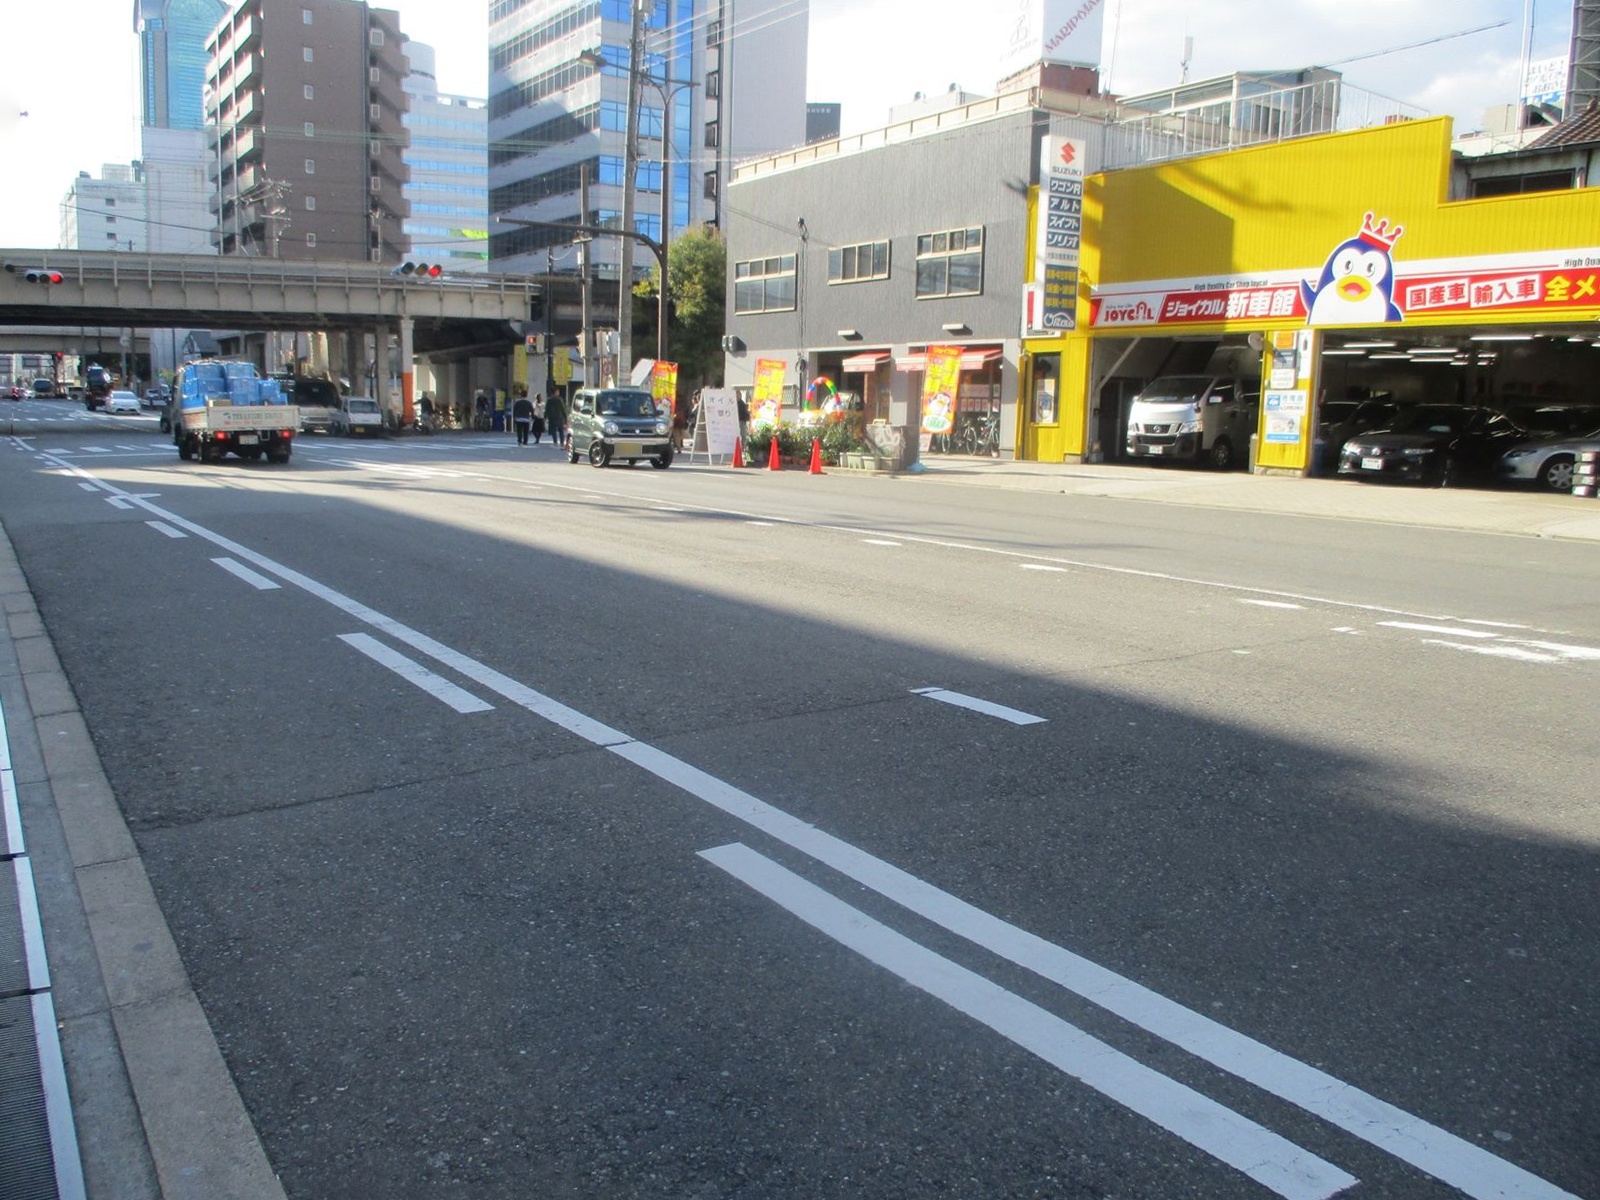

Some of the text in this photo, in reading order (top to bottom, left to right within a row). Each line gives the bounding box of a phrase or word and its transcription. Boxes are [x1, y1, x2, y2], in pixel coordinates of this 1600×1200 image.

[1052, 165, 1082, 177] SUZUKI
[1050, 180, 1081, 195] ワゴンR
[1050, 198, 1079, 212] アルト
[1049, 216, 1079, 230] スイフト
[1048, 233, 1078, 248] ソリオ
[1564, 258, 1583, 268] High
[1409, 283, 1466, 308] 国産車
[1544, 275, 1600, 302] 全メ
